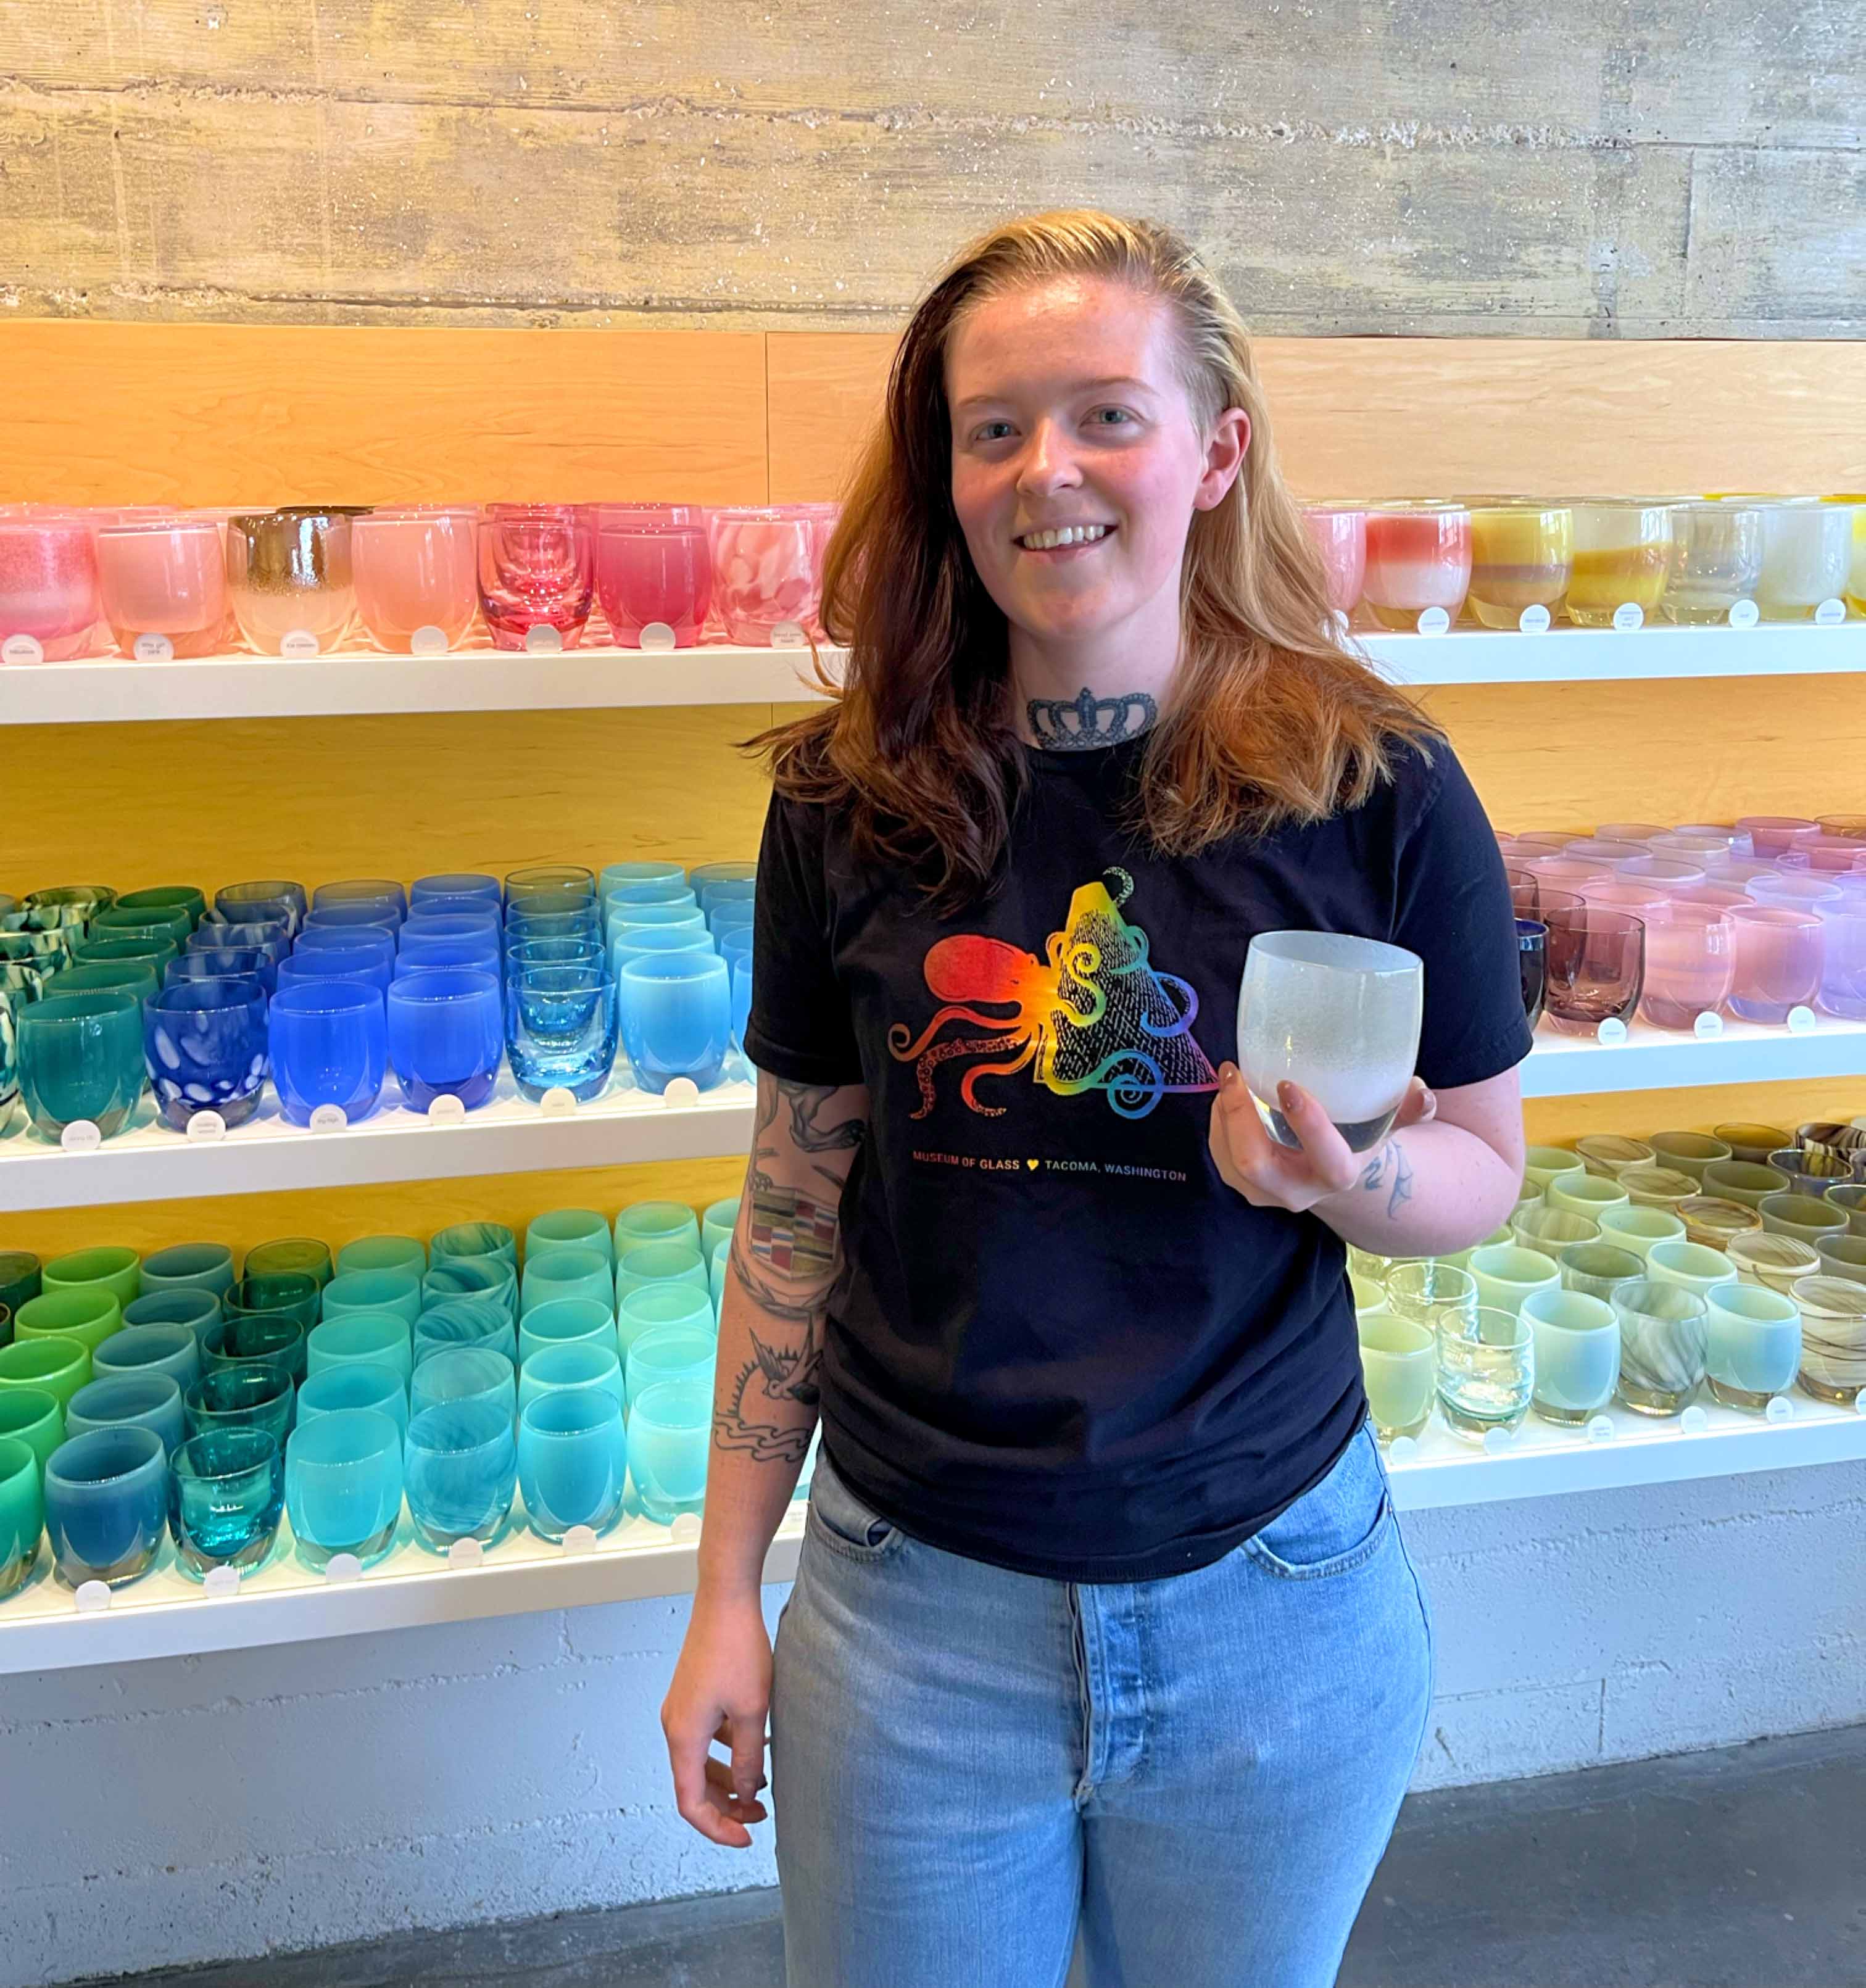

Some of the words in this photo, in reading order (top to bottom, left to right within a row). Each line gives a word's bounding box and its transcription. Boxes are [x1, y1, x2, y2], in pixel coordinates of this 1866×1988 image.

[913, 1150, 959, 1166] MUSEUM
[962, 1157, 976, 1167] OF
[979, 1159, 1020, 1170] GLASS
[1045, 1160, 1101, 1174] TACOMA,
[1105, 1163, 1187, 1182] WASHINGTON
